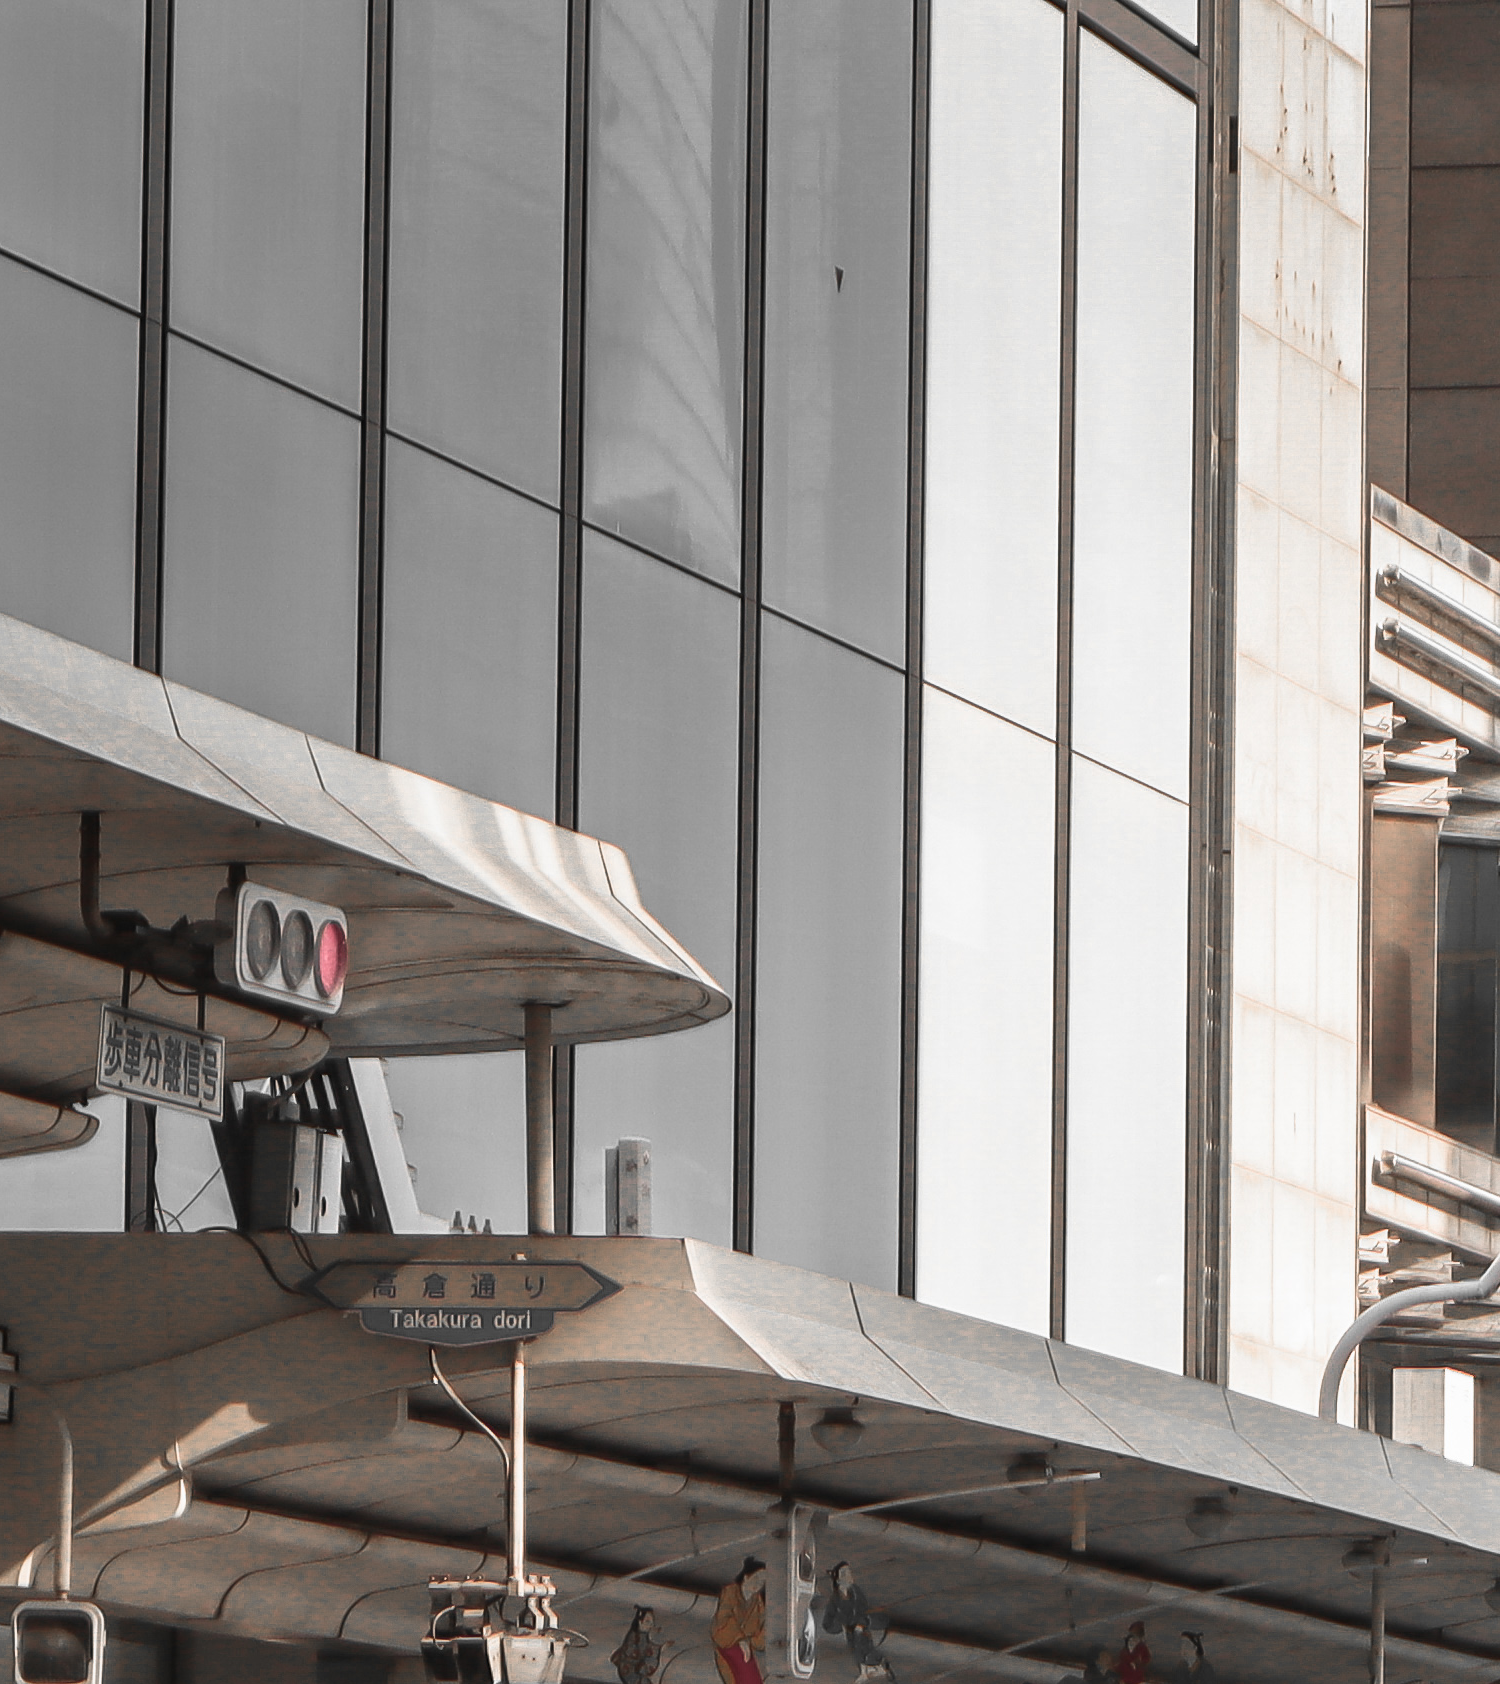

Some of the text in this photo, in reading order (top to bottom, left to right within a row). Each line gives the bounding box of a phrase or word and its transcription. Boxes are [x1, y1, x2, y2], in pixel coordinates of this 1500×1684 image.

[104, 1021, 220, 1101] 歩車分離信号
[372, 1272, 547, 1299] 高倉通り
[390, 1308, 532, 1330] Takakura dori
